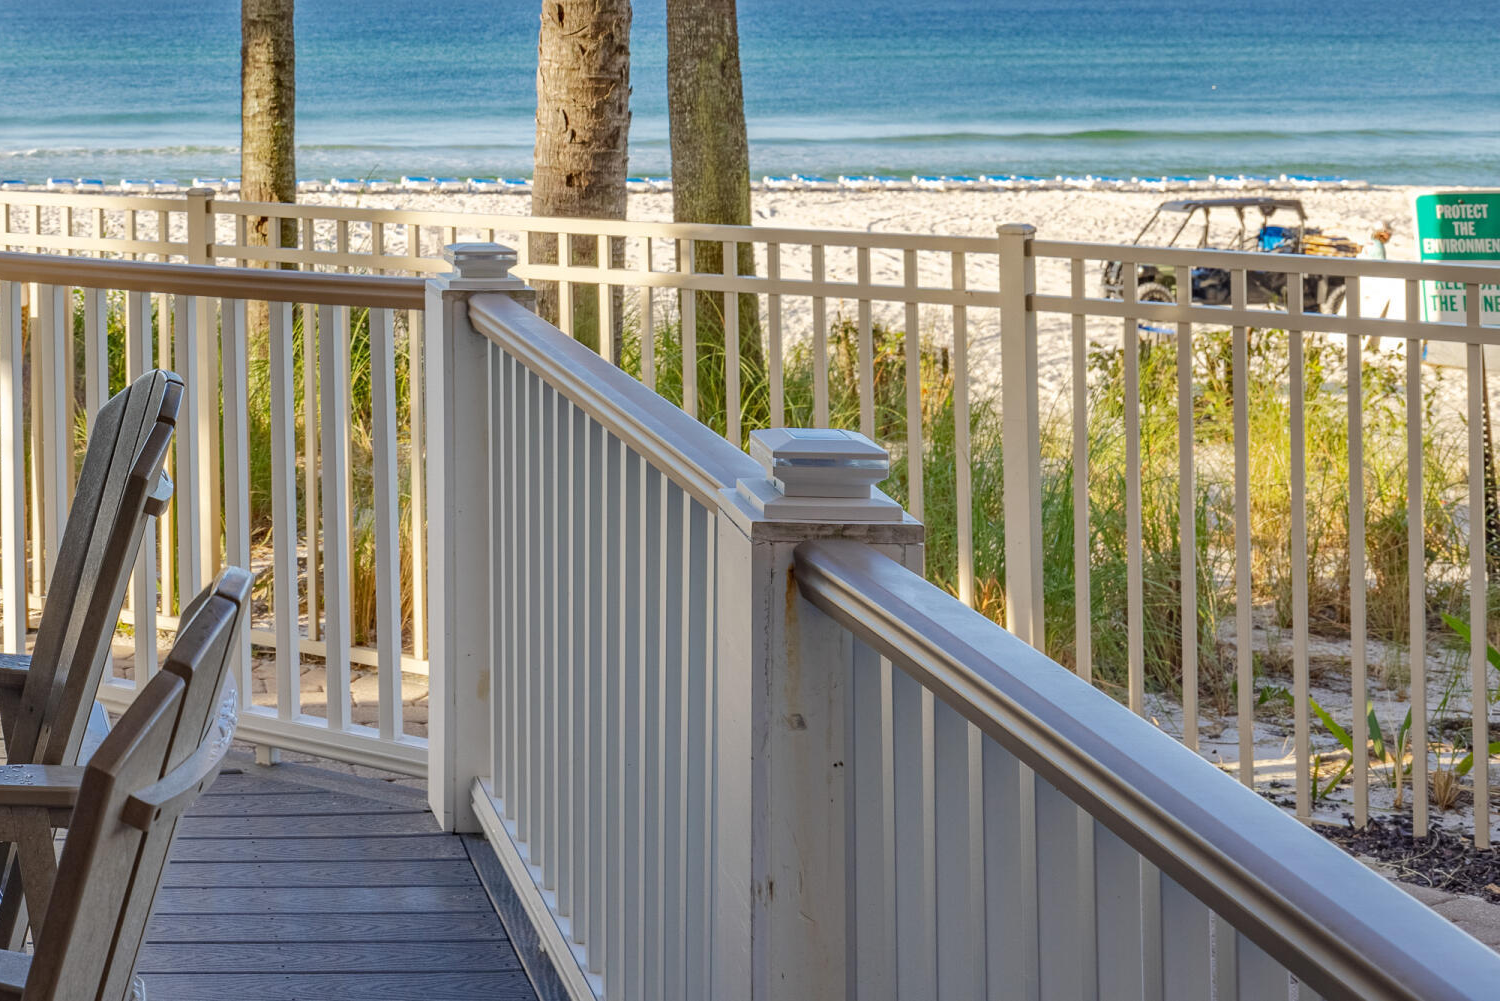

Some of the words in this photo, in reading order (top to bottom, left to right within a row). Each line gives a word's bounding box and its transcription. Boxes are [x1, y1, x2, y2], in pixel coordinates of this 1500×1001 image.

[1436, 203, 1489, 219] PROTECT
[1452, 221, 1476, 236] THE
[1430, 295, 1458, 312] THE
